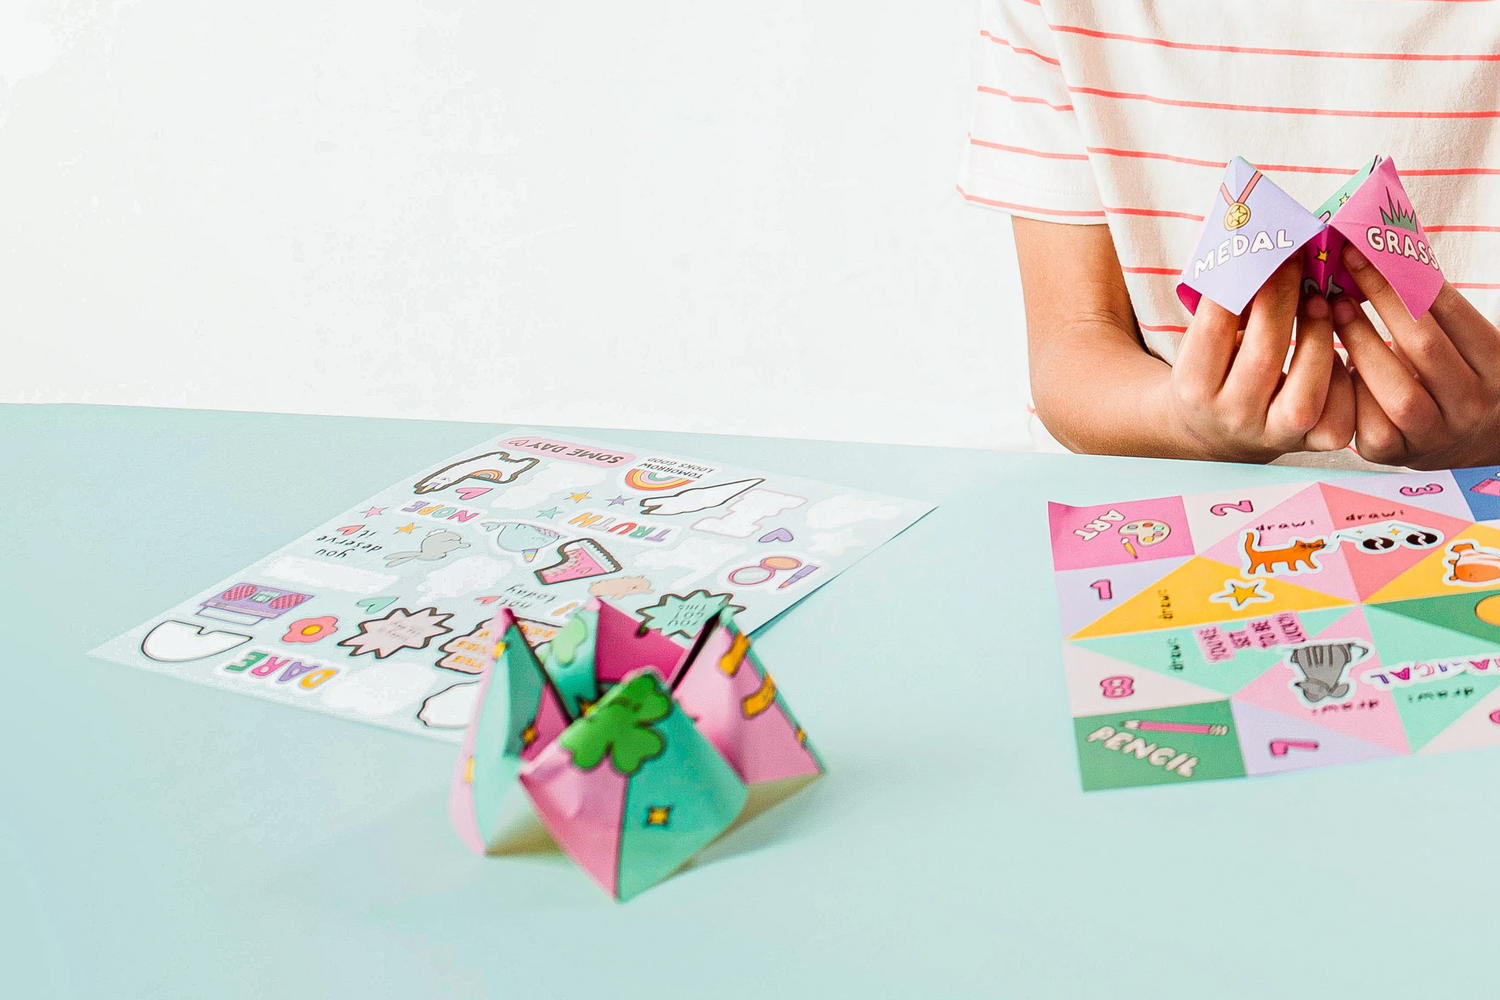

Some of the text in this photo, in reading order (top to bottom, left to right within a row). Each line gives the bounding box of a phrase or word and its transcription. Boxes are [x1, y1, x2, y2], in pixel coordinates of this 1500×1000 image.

[1193, 229, 1295, 281] MEDAL
[1366, 226, 1440, 271] GRASS
[526, 440, 625, 465] SOME DAY
[639, 461, 704, 480] TOMORROW
[646, 456, 715, 474] LOOKS GOOD
[1400, 483, 1444, 497] 3
[401, 500, 481, 523] NOPE
[1210, 499, 1254, 517] 2
[358, 529, 376, 539] it
[568, 511, 673, 543] TRUTH
[1073, 508, 1126, 542] ART
[314, 548, 356, 559] you
[315, 534, 384, 553] deserve
[505, 583, 557, 602] today
[1090, 578, 1113, 600] 1
[677, 603, 708, 612] THIS
[225, 650, 337, 690] DARE
[1099, 675, 1135, 699] 8
[1087, 725, 1199, 778] PENCIL
[1269, 738, 1319, 757] 7
